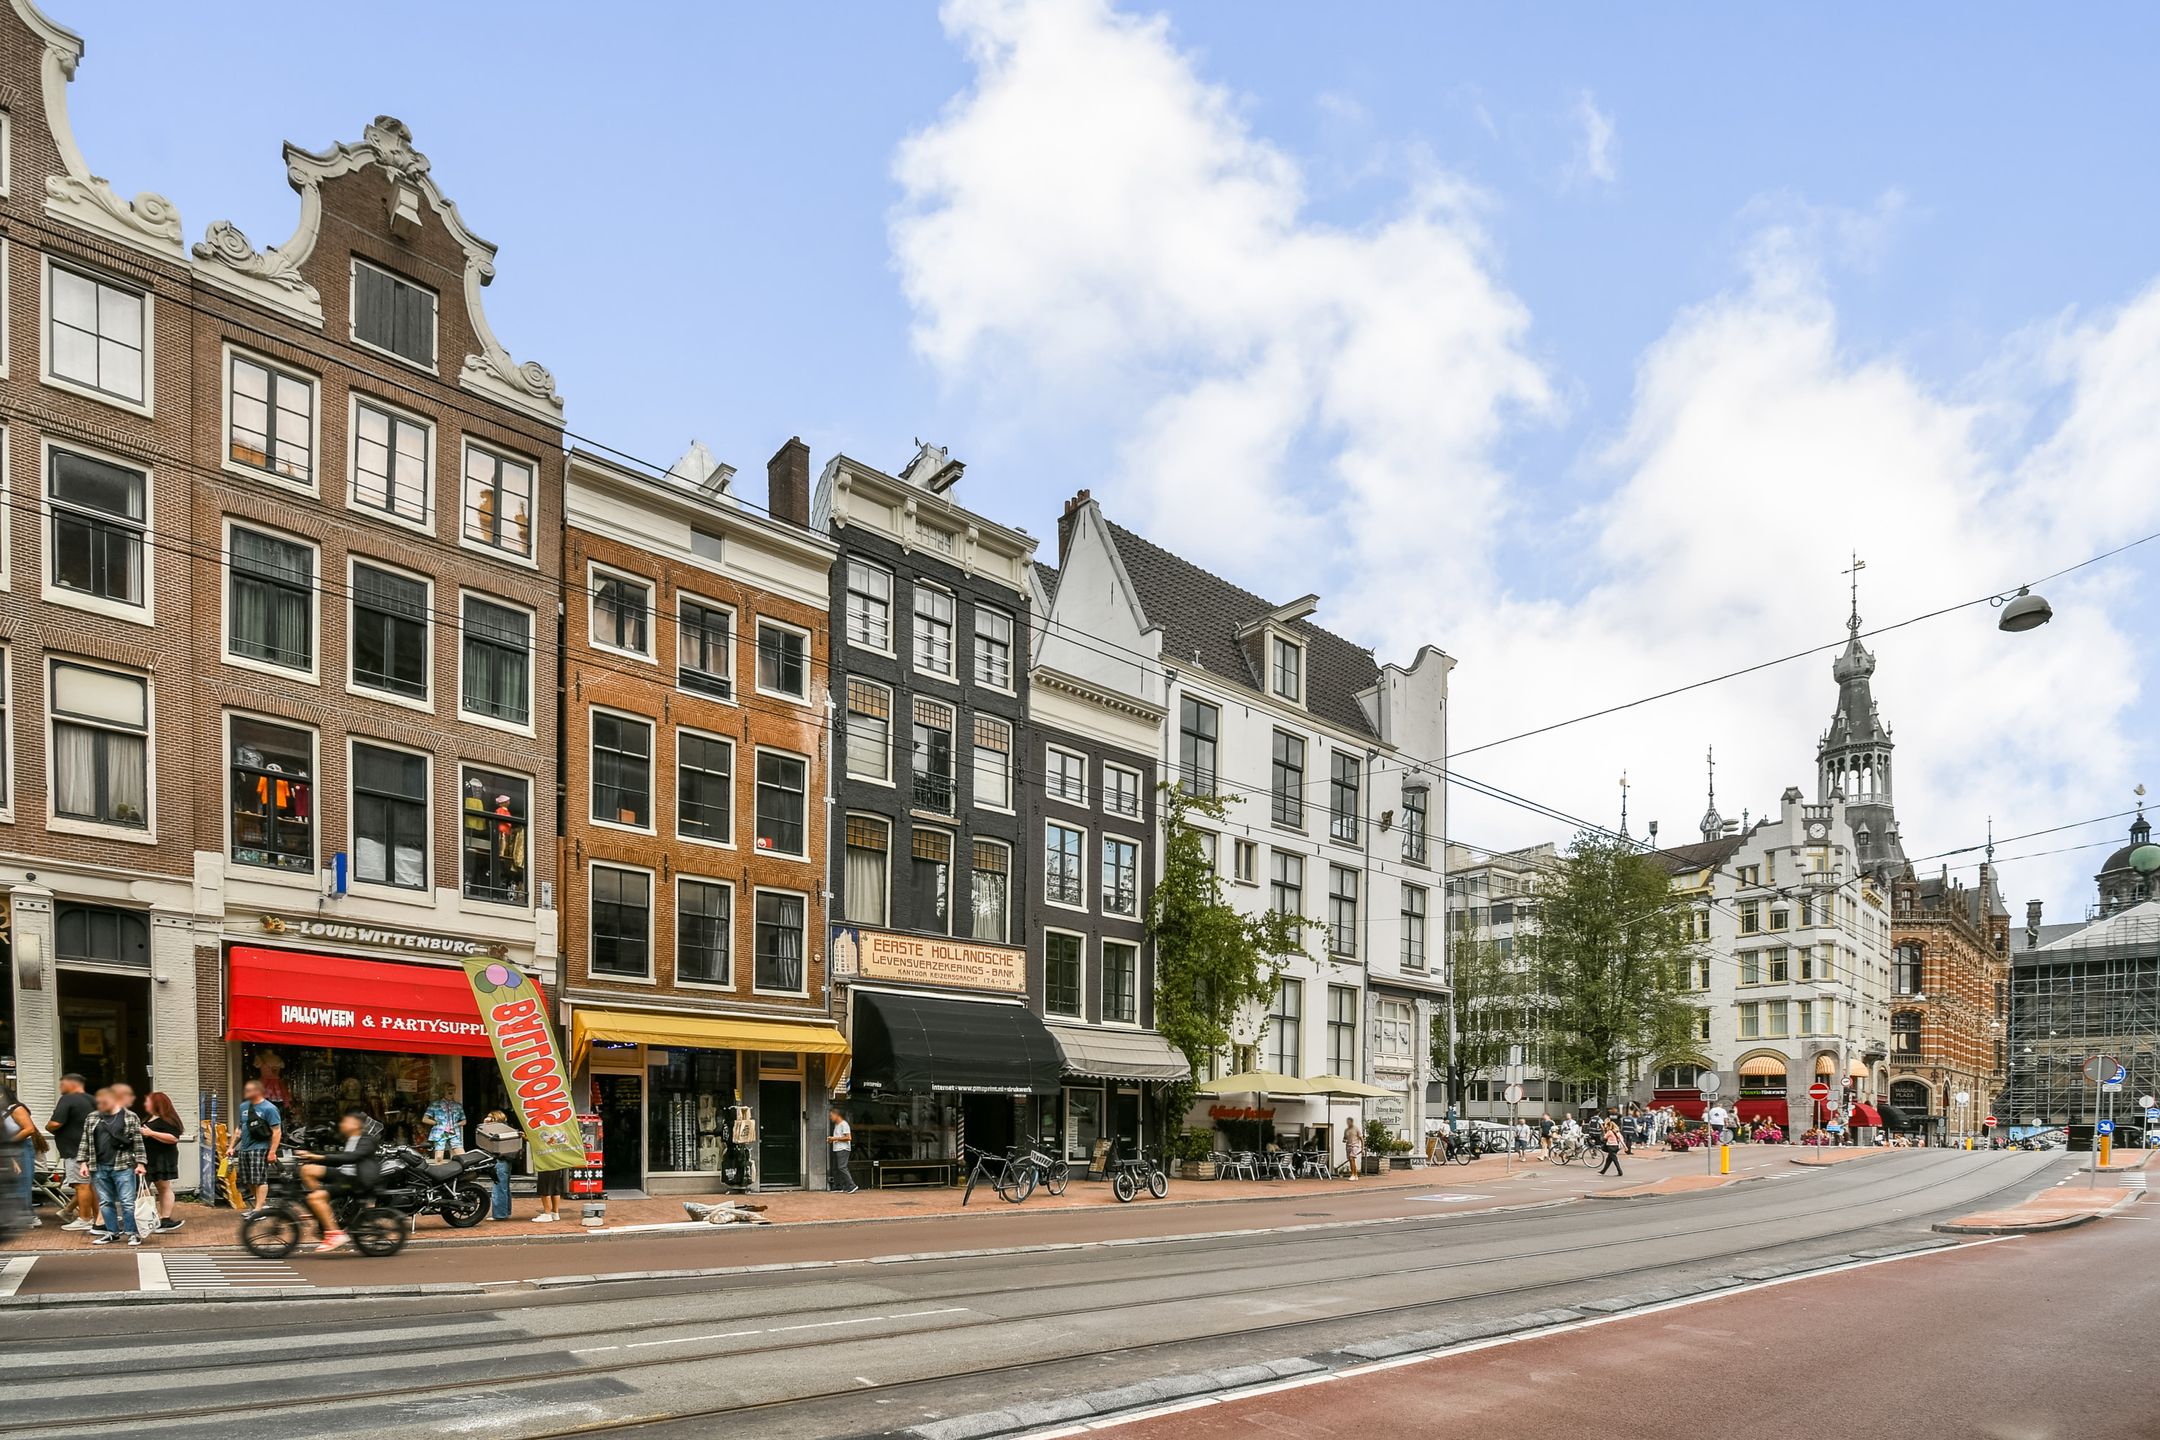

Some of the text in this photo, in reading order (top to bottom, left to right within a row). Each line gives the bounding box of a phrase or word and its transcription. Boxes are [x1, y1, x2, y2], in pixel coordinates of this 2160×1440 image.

[874, 938, 1013, 967] EERSTE HOLLANDSCHE
[897, 968, 928, 978] KANTOOR
[930, 972, 978, 983] KEIZERSGRACHT
[991, 968, 1015, 980] BANK
[281, 1005, 488, 1036] HALLOWEEN & PARTYSUPPL
